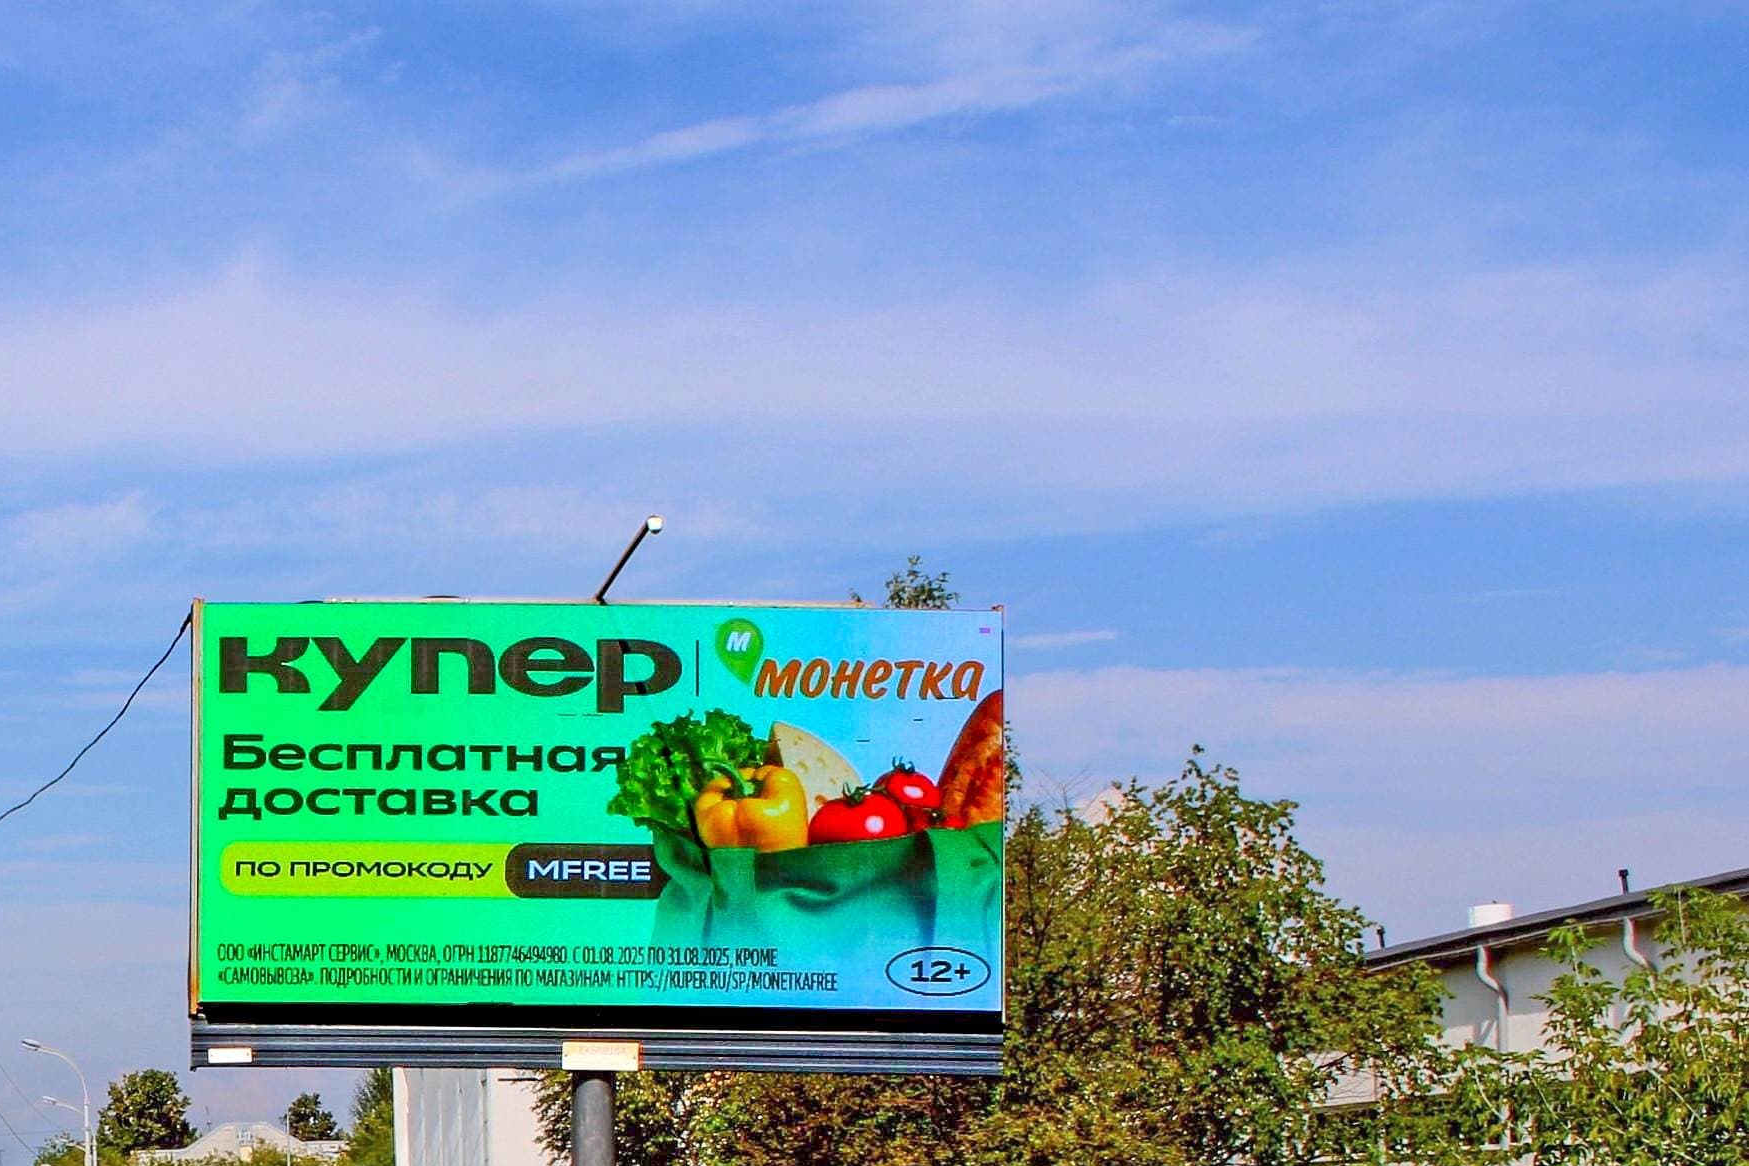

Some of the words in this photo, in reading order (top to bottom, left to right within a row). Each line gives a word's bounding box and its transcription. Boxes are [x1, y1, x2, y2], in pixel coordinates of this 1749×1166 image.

[218, 636, 683, 714] купер
[222, 734, 627, 773] Бесплатная
[218, 788, 539, 821] доставка
[235, 861, 281, 878] ПО
[289, 861, 493, 881] ПРОМОКОДУ
[527, 859, 652, 882] MFREE
[217, 943, 245, 962] ООО
[246, 943, 326, 963] «ИНСТАМАРТ
[387, 944, 441, 965] МОСКВА,
[443, 945, 475, 963] ОГРН
[582, 946, 644, 965] 01.08.2025
[647, 947, 665, 966] ПО
[667, 947, 734, 969] 31.08.2025,
[736, 948, 778, 967] КРОМЕ
[320, 967, 412, 988] ПОДРОБНОСТИ
[414, 968, 422, 985] И
[425, 968, 512, 987] ОГРАНИЧЕНИЯ
[515, 969, 533, 987] ПО
[910, 960, 971, 982] 12+
